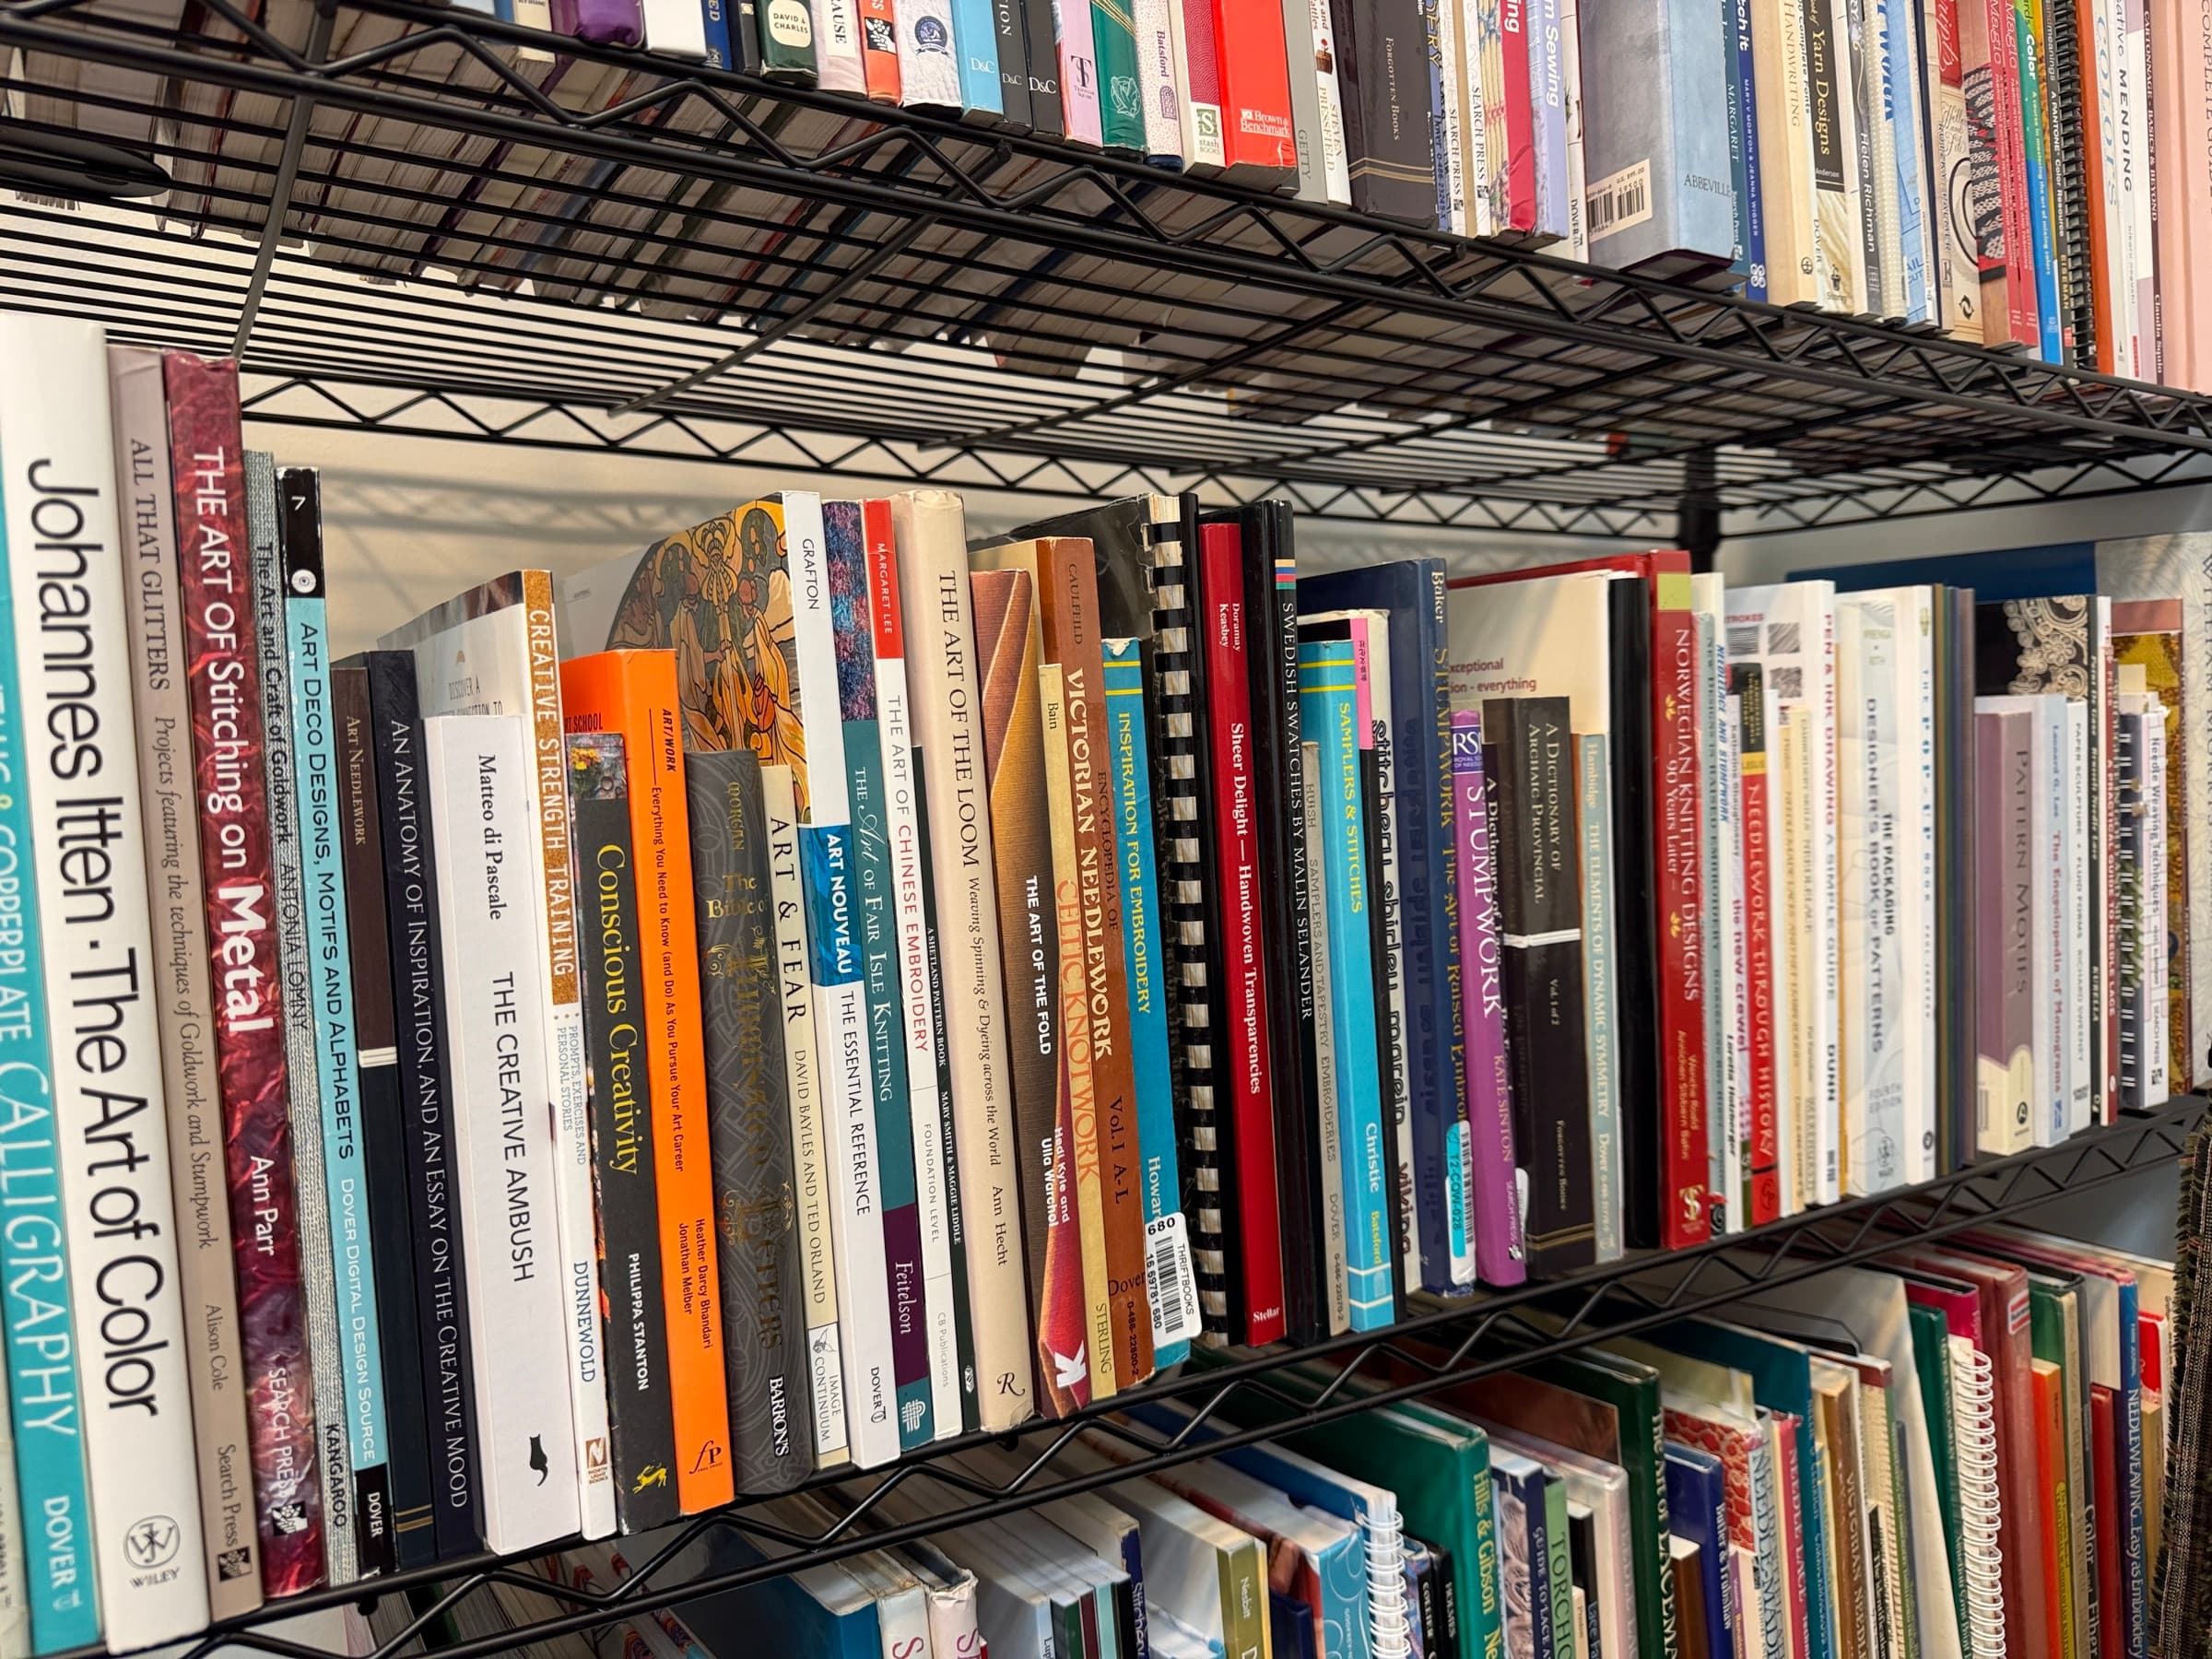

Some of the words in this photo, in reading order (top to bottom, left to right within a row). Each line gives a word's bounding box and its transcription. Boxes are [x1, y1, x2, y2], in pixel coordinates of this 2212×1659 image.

[773, 13, 799, 23] DAVID
[774, 22, 808, 34] CHARLES
[1813, 29, 1825, 72] Yarn
[971, 58, 994, 74] D&C
[1002, 73, 1023, 86] D&C
[1029, 76, 1056, 94] D&C
[1157, 30, 1169, 76] Batsford
[1546, 25, 1559, 106] Sewing
[2026, 33, 2039, 79] Color
[1240, 119, 1289, 136] Benchmark
[1450, 109, 1460, 156] SEARCH
[1473, 87, 1483, 136] SEARCH
[1815, 80, 1830, 154] Designs
[2119, 69, 2131, 191] MENDING
[1298, 129, 1311, 179] GETTY
[1453, 159, 1462, 195] PRESS
[1476, 143, 1484, 179] PRESS
[1860, 132, 1872, 179] Helen
[1864, 182, 1874, 251] Richman
[131, 441, 153, 485] ALL
[193, 445, 229, 516] THE
[135, 493, 160, 562] THAT
[197, 524, 237, 594] ART
[802, 538, 818, 608] GRAFTON
[939, 571, 959, 621] THE
[1431, 571, 1443, 622] Baker
[28, 458, 103, 781] Johannes
[143, 570, 170, 690] GLITTERS
[203, 601, 241, 650] OF
[1283, 603, 1296, 692] SWEDISH
[529, 608, 556, 721] CREATIVE
[944, 631, 963, 681] ART
[888, 695, 902, 735] THE
[949, 688, 967, 722] OF
[1676, 629, 1691, 772] NORWEGIAN
[206, 658, 252, 813] Stitching
[892, 745, 906, 780] ART
[953, 729, 971, 780] THE
[1287, 701, 1300, 807] SWATCHES
[1338, 702, 1355, 801] SAMPLERS
[478, 755, 496, 820] Matteo
[538, 738, 564, 848] STRENGTH
[896, 789, 909, 814] OF
[1119, 712, 1136, 834] INSPIRATION
[484, 828, 501, 843] di
[958, 788, 979, 865] LOOM
[1292, 817, 1302, 838] BY
[1344, 804, 1356, 818] &
[1678, 783, 1694, 893] KNITTING
[56, 795, 124, 923] Itten
[216, 823, 244, 867] on
[771, 816, 793, 881] ART
[827, 834, 842, 869] ART
[899, 825, 916, 913] CHINESE
[1067, 667, 1094, 832] VICTORIAN
[1081, 846, 1111, 1059] NEEDLEWORK
[1127, 841, 1139, 880] FOR
[1294, 847, 1306, 909] MALIN
[1346, 824, 1361, 914] STITCHES
[1747, 784, 1764, 940] NEEDLEWORK
[486, 852, 506, 919] Pascale
[778, 900, 795, 921] &
[1026, 876, 1038, 908] THE
[1466, 785, 1501, 1017] STUMPWORK
[547, 864, 573, 974] TRAINING
[597, 844, 629, 1013] Conscious
[830, 877, 851, 973] NOUVEAU
[1029, 912, 1041, 944] ART
[1053, 878, 1084, 982] CELTIC
[1130, 887, 1149, 1012] EMBROIDERY
[1682, 903, 1698, 999] DESIGNS
[220, 884, 274, 1031] Metal
[781, 940, 805, 1024] FEAR
[906, 924, 927, 1050] EMBROIDERY
[1032, 949, 1043, 970] OF
[1034, 974, 1047, 1007] THE
[1297, 917, 1311, 1018] SELANDER
[70, 947, 139, 1074] The
[492, 971, 515, 1023] THE
[1753, 948, 1769, 1055] THROUGH
[1037, 1011, 1050, 1053] FOLD
[497, 1034, 524, 1158] CREATIVE
[609, 1024, 641, 1173] Creativity
[1063, 990, 1099, 1179] KNOTWORK
[1494, 1055, 1505, 1095] KATE
[81, 1084, 149, 1176] Art
[1498, 1100, 1511, 1160] SINTON
[1759, 1067, 1771, 1155] HISTORY
[248, 1157, 274, 1201] Ann
[1366, 1123, 1380, 1192] Christie
[90, 1184, 159, 1243] of
[254, 1207, 277, 1254] Parr
[506, 1170, 533, 1281] AMBUSH
[993, 1187, 1002, 1215] Ann
[1147, 1217, 1176, 1236] 680
[0, 1062, 76, 1434] CALLIGRAPHY
[995, 1222, 1007, 1265] Hecht
[629, 1253, 642, 1318] PHILIPPA
[1177, 1242, 1194, 1315] THRIFTBOOKS
[96, 1253, 170, 1418] Color
[573, 1261, 594, 1382] DUNNEWOLD
[1096, 1303, 1112, 1372] STERLING
[633, 1322, 648, 1390] STANTON
[218, 1444, 237, 1500] Search
[326, 1423, 346, 1528] KANGAROO
[1473, 1468, 1490, 1512] Hills
[43, 1495, 77, 1589] DOVER
[222, 1503, 242, 1547] Press
[1476, 1519, 1492, 1537] &
[1241, 1576, 1251, 1618] Nesbitt
[1477, 1540, 1497, 1614] Gibson
